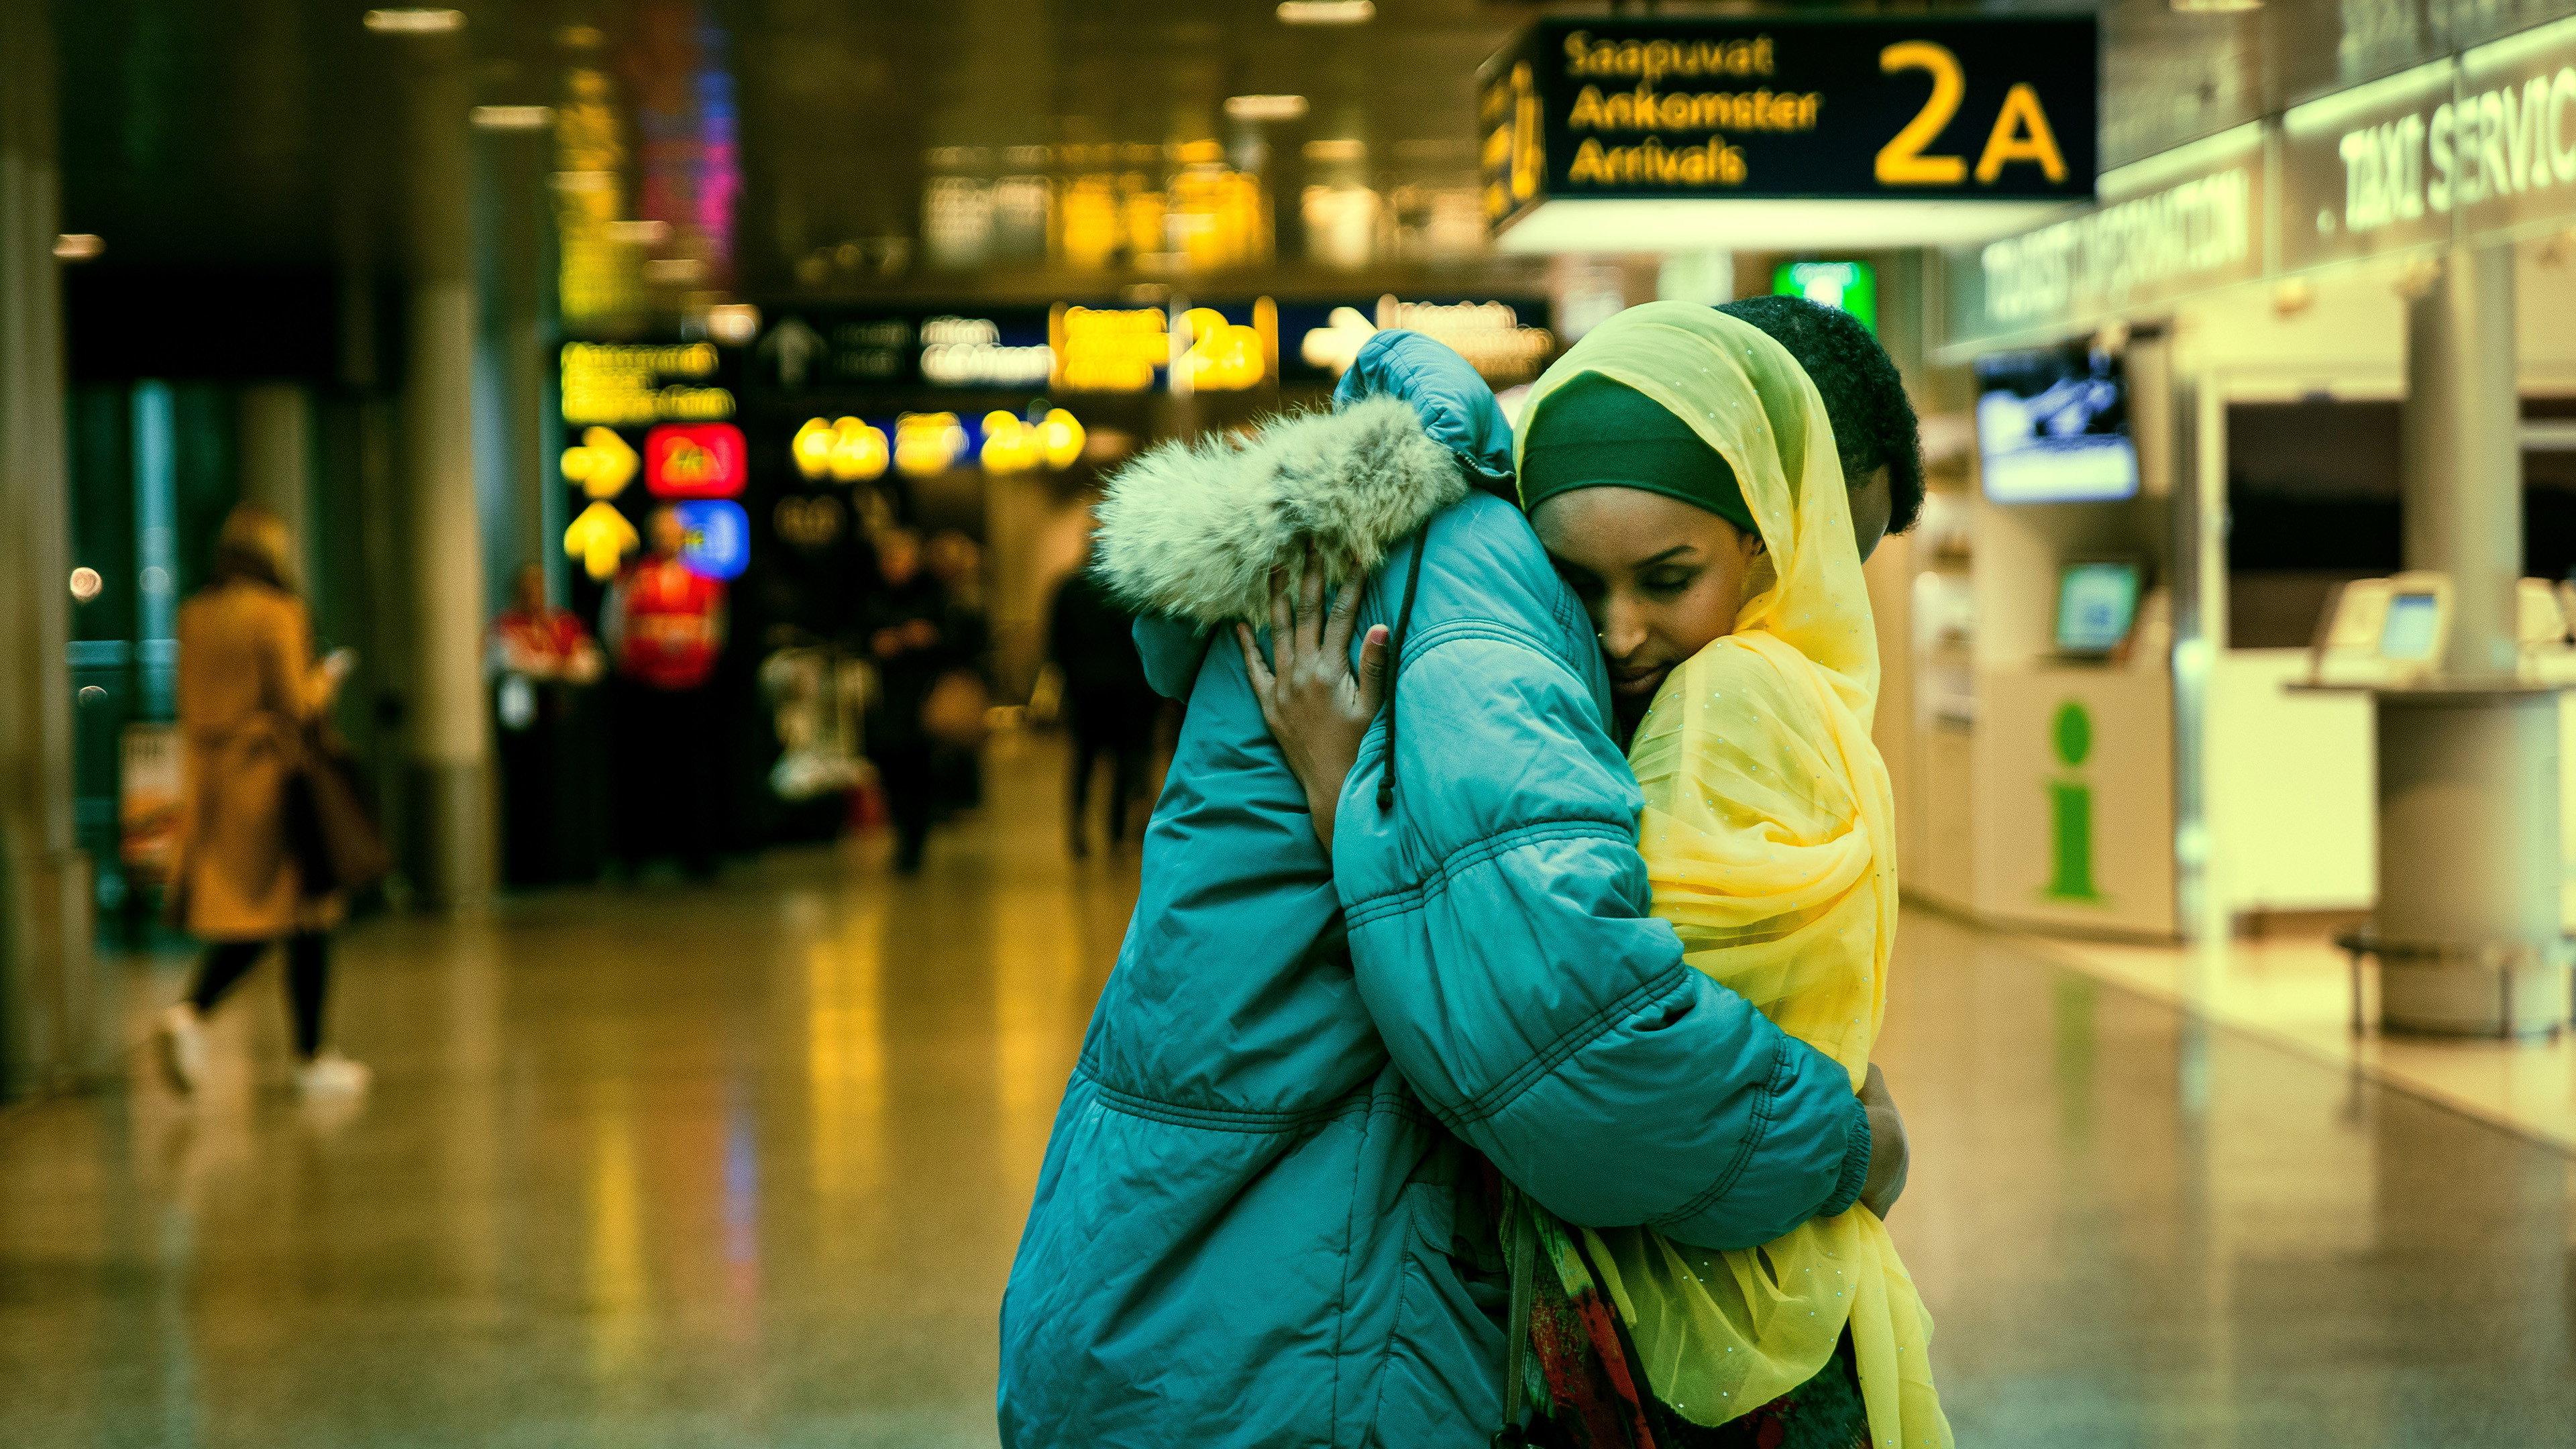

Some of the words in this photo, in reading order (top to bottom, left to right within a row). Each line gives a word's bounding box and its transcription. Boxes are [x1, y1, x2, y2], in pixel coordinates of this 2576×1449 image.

[1564, 30, 1776, 85] Saapuvat
[1568, 79, 1825, 131] Ankomster
[1874, 39, 2071, 186] 2A
[1568, 135, 1748, 186] Arrivals
[2339, 112, 2424, 231] TAXI
